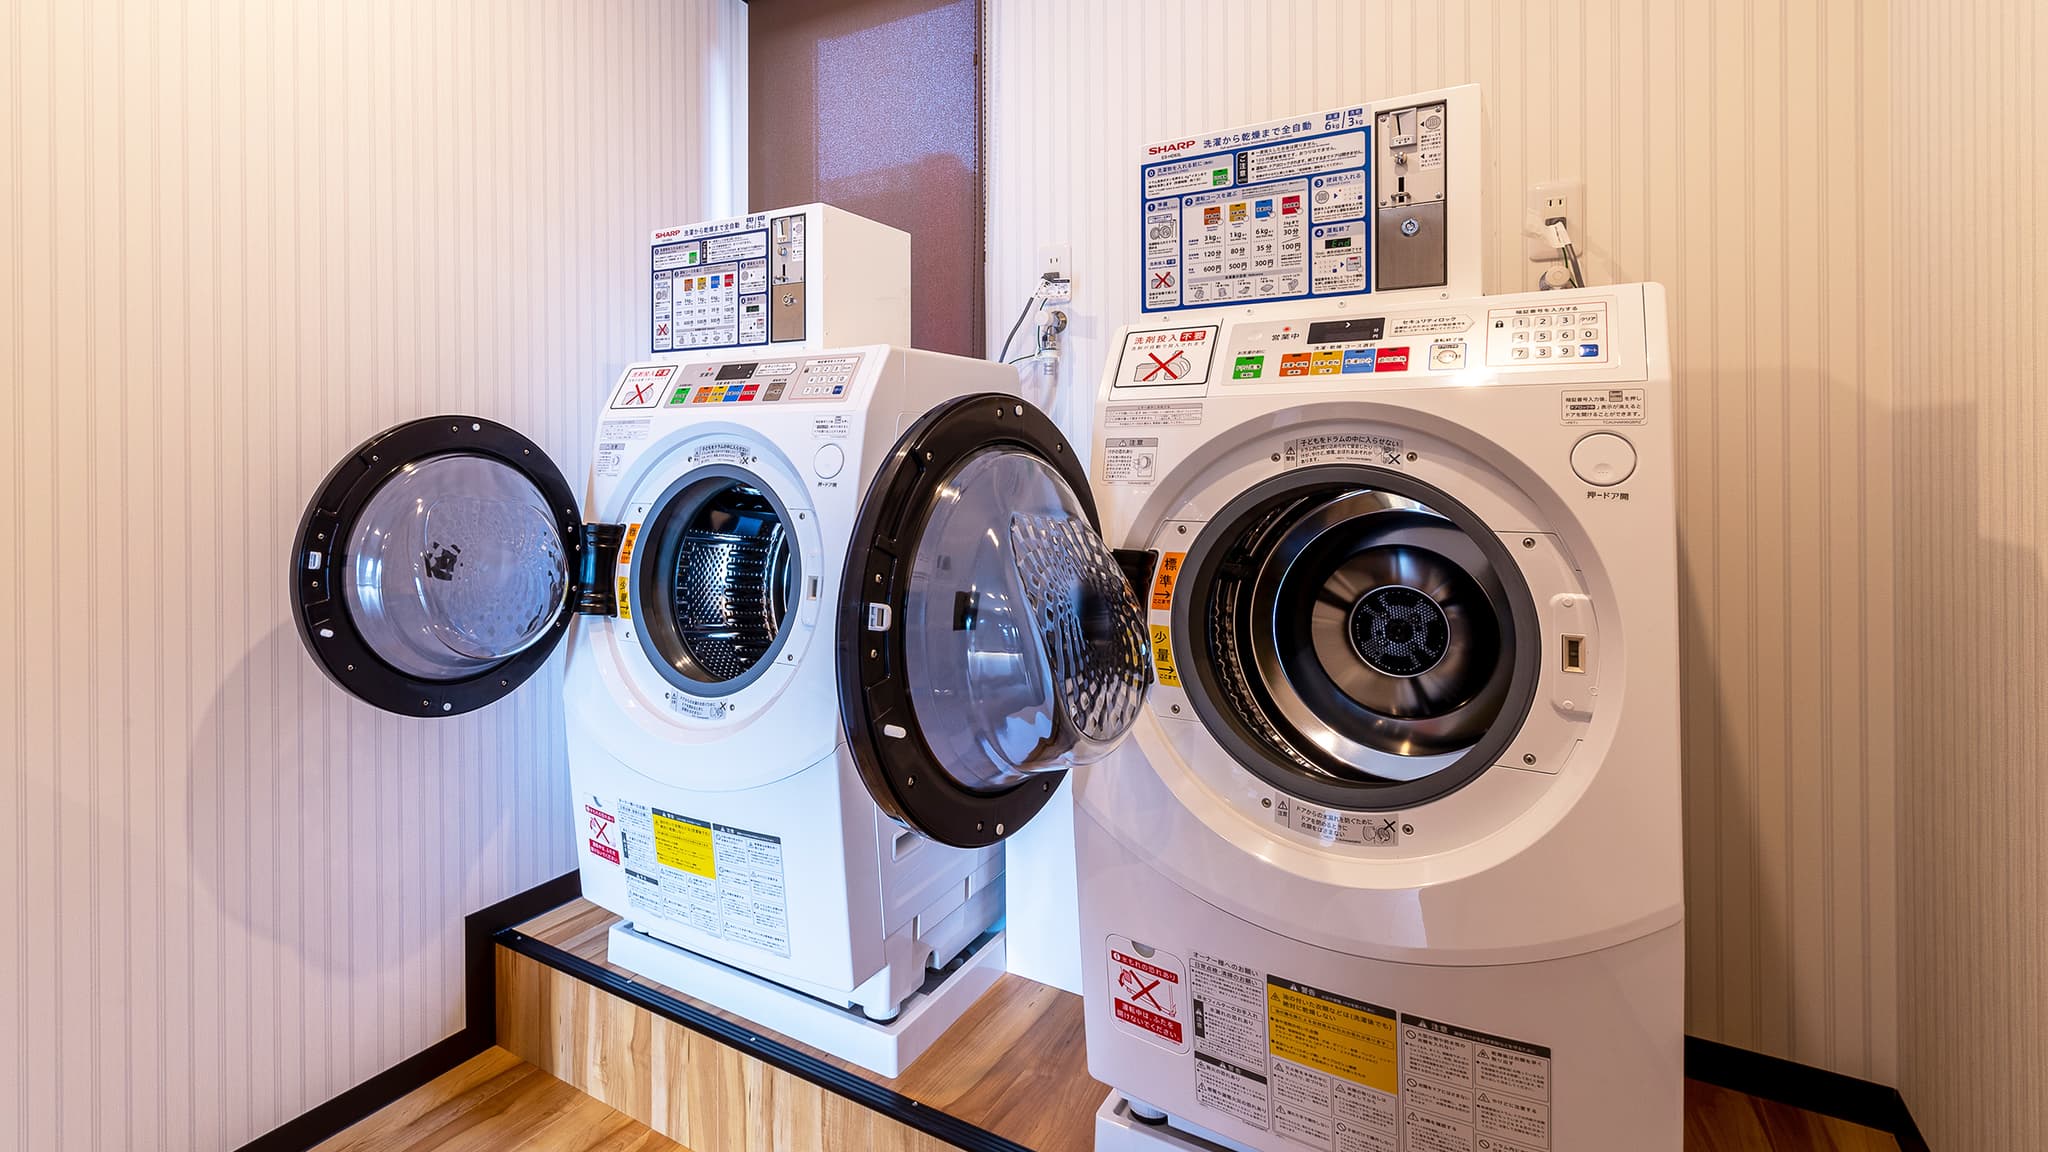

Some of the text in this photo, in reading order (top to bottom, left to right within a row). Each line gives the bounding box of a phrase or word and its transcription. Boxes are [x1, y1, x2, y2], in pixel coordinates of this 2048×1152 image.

[1203, 120, 1312, 148] 洗濯から乾燥まで全自動
[1148, 140, 1196, 155] SHARP
[656, 230, 680, 240] SHARP
[1282, 242, 1301, 251] 100円
[1229, 262, 1248, 270] 500円
[1255, 259, 1274, 268] 300円
[1204, 265, 1222, 273] 600円
[1134, 332, 1205, 345] 洗剤投入 不要
[1272, 333, 1300, 341] 営業中
[1300, 436, 1400, 446] 子どもをドラムの中に入らせない
[1160, 558, 1177, 588] 標準
[1154, 630, 1168, 662] 少量
[1193, 952, 1259, 977] オーナー様へのお願い
[1300, 986, 1316, 996] 警告
[1122, 1003, 1174, 1029] 運転中は、ふたを
